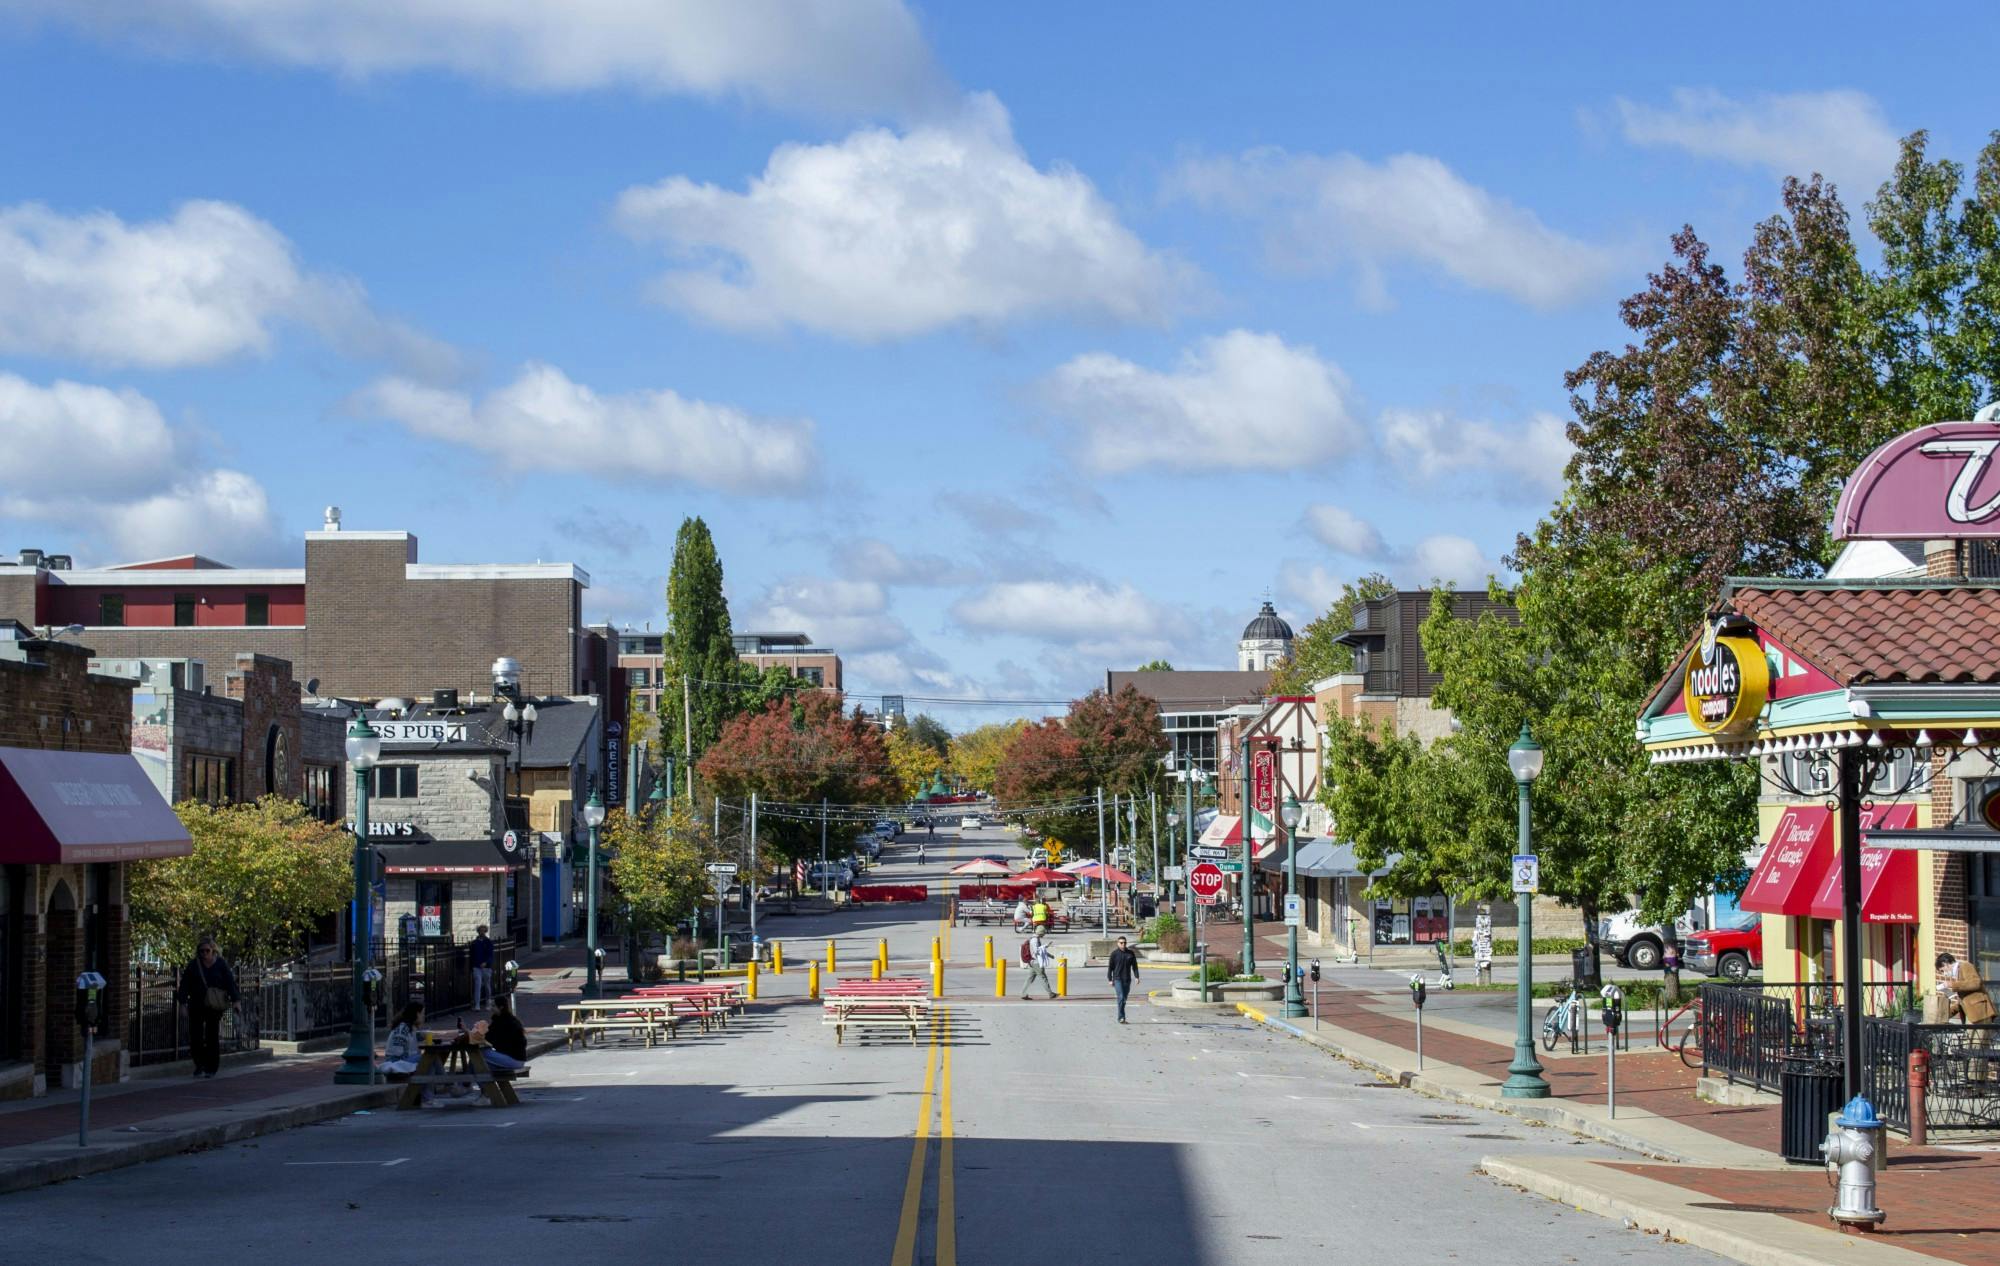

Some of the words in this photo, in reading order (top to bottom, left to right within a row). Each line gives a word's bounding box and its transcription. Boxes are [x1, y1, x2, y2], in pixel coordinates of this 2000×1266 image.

[1691, 646, 1736, 697] noodles
[403, 725, 444, 739] PUB
[608, 741, 617, 800] RECESS
[347, 822, 413, 836] JHN'S
[1786, 823, 1814, 846] Bicycle
[1192, 872, 1222, 887] STOP
